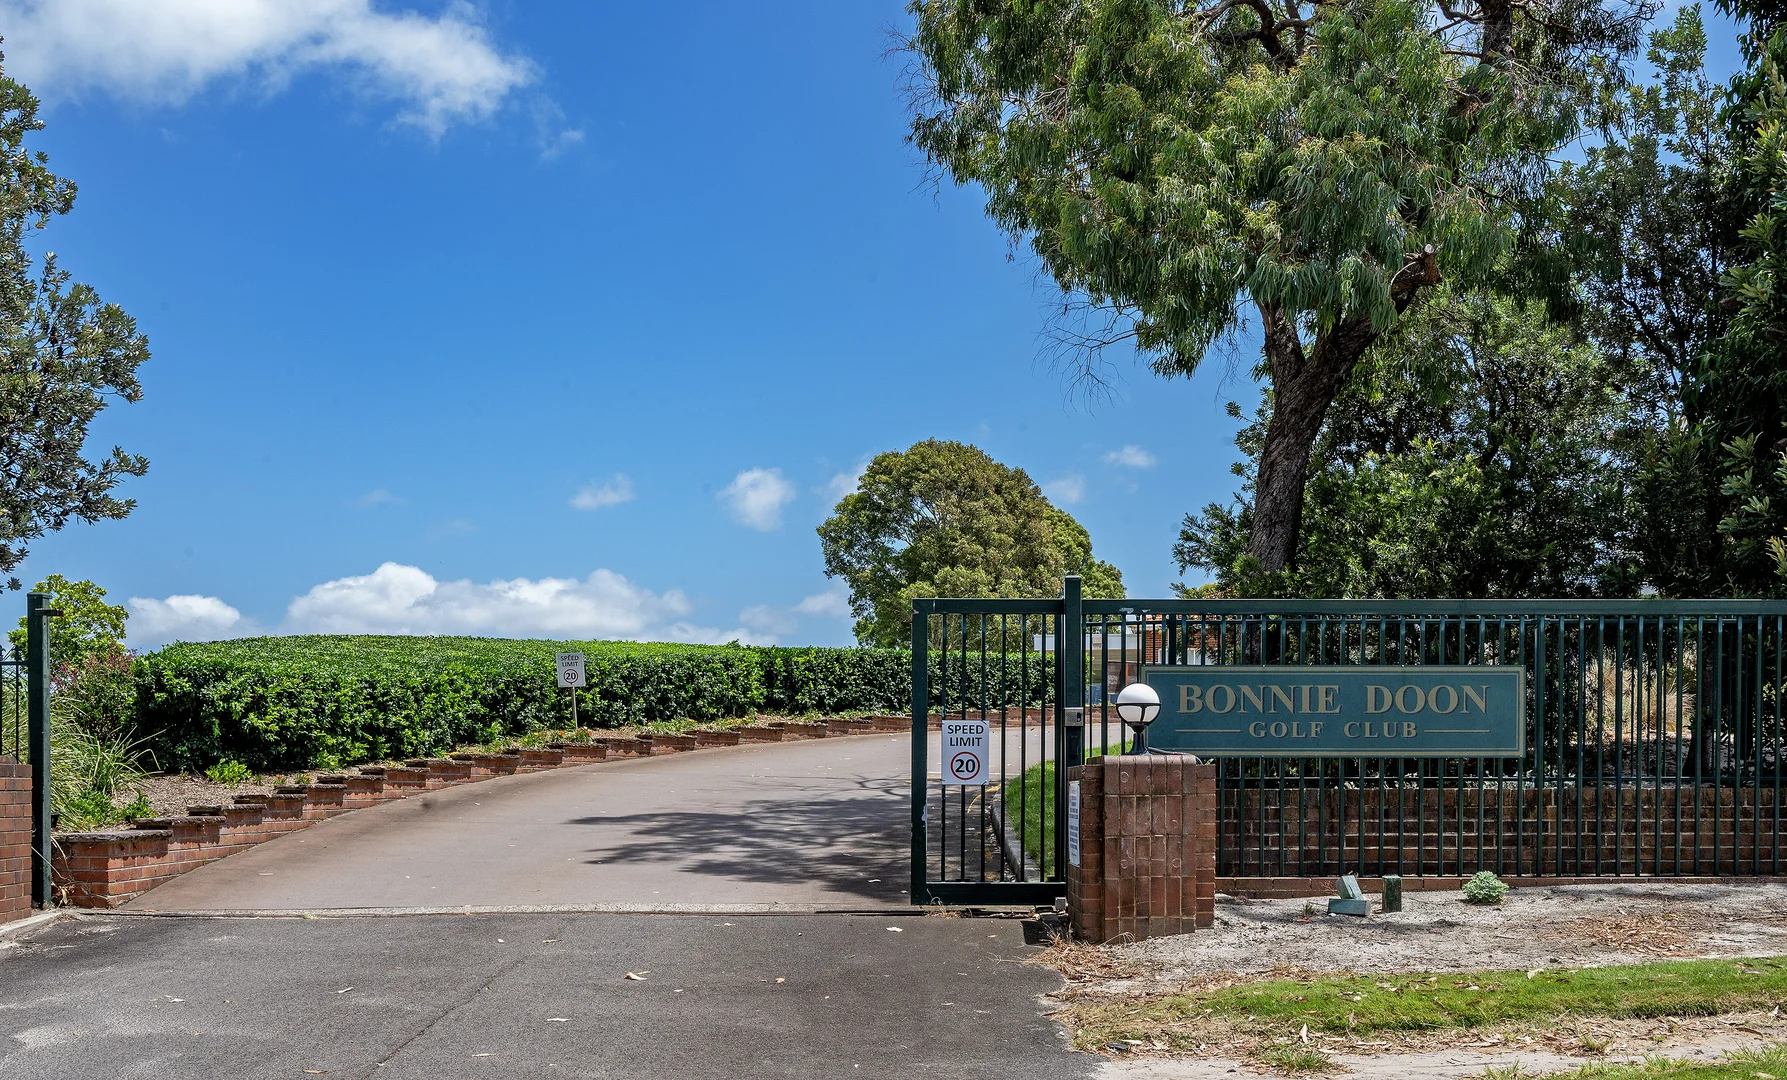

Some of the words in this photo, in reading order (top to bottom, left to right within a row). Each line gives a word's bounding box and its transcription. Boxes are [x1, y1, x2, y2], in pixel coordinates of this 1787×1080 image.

[565, 672, 576, 680] 20
[1176, 684, 1342, 714] BONNIE
[1364, 684, 1491, 714] DOON
[947, 724, 984, 735] SPEED
[1249, 721, 1325, 739] GOLF
[1343, 721, 1418, 739] CLUB
[949, 737, 982, 747] LIMIT
[955, 758, 976, 773] 20
